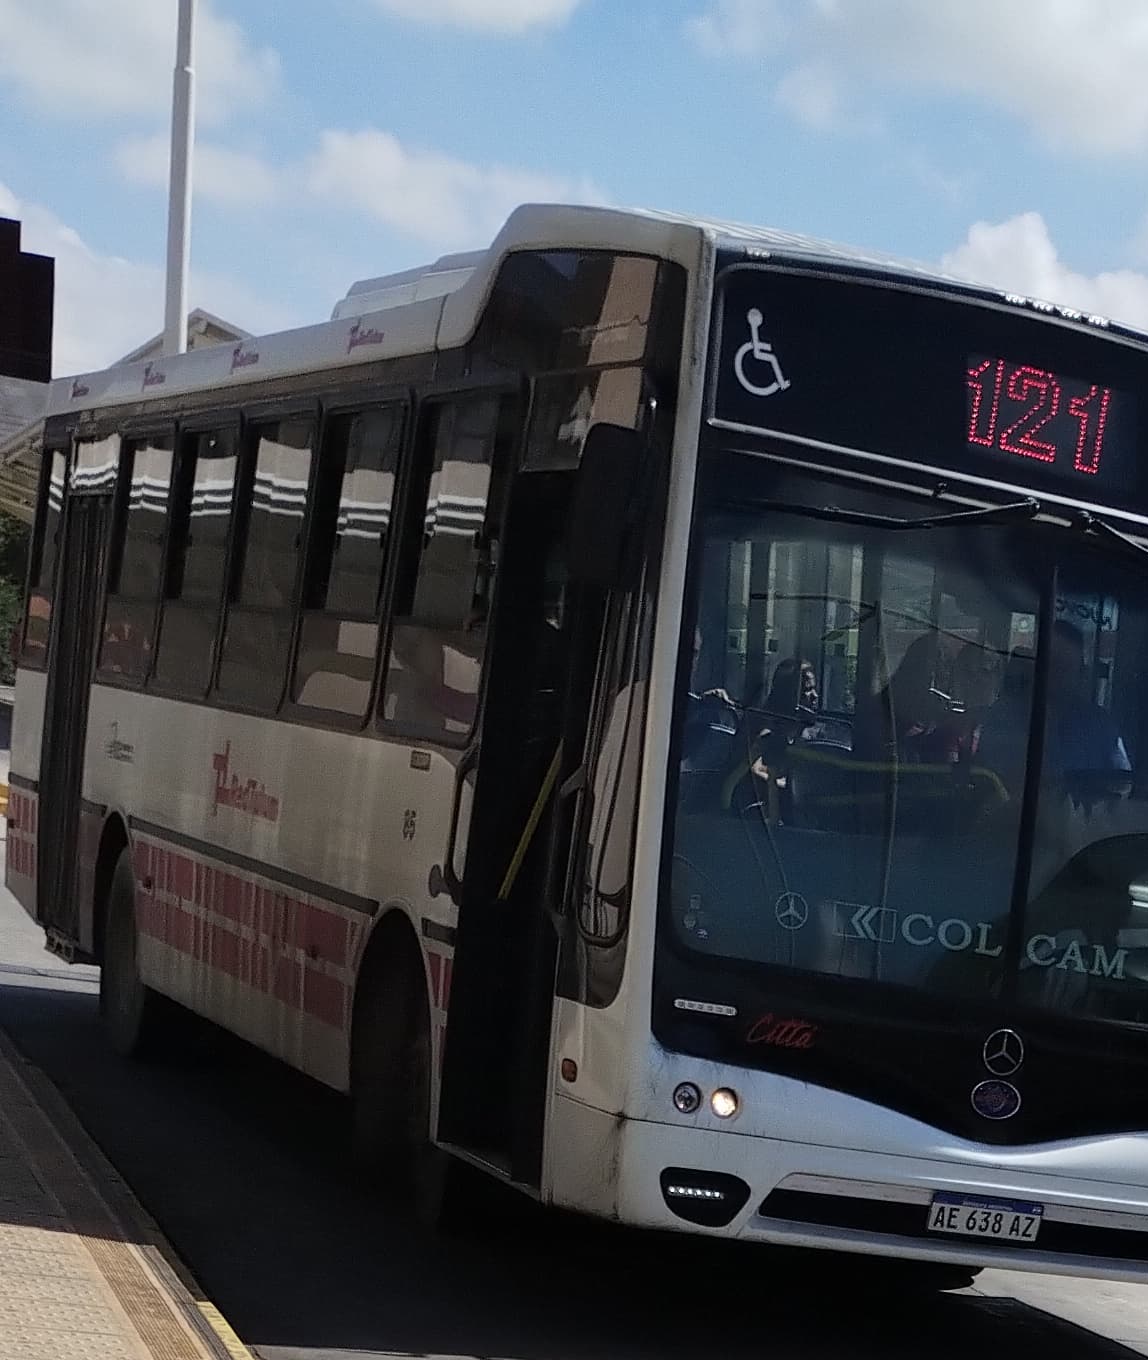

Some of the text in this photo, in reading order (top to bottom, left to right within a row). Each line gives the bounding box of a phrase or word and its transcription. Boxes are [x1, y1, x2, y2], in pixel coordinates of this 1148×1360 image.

[967, 357, 1113, 475] 121
[900, 911, 1130, 981] COL CAM
[932, 1206, 960, 1230] AE
[965, 1209, 1003, 1234] 638
[1008, 1215, 1036, 1238] AZ
